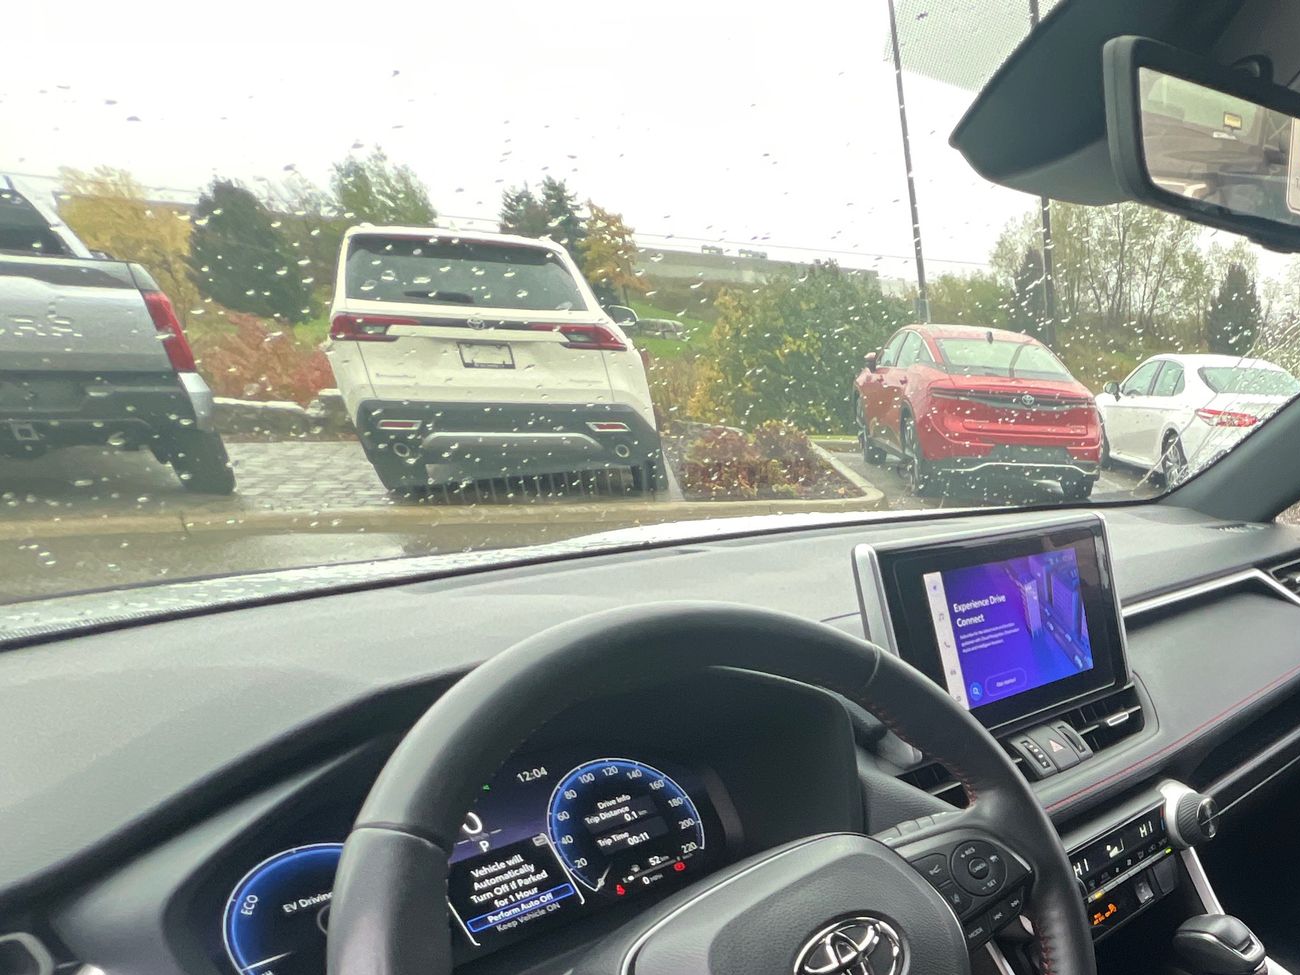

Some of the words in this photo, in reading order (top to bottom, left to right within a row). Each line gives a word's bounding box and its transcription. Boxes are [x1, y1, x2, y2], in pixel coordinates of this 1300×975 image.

[953, 598, 990, 614] Experience
[989, 594, 1007, 606] Drive
[956, 613, 985, 628] Connect
[516, 766, 548, 782] 12:04
[602, 765, 619, 777] 120
[626, 768, 643, 781] 140
[578, 772, 595, 784] 100
[649, 779, 665, 791] 160
[563, 789, 578, 800] 80
[597, 797, 616, 810] Drive
[616, 793, 631, 803] Info
[668, 796, 684, 808] 180
[557, 810, 570, 822] 60
[584, 814, 600, 825] Trip
[600, 806, 630, 822] Distance
[623, 810, 638, 822] 0.1
[678, 817, 695, 830] 200
[1139, 820, 1154, 838] HI
[560, 834, 574, 845] 40
[597, 836, 613, 848] Trip
[612, 832, 630, 842] Time
[627, 832, 650, 846] 00:11
[479, 840, 490, 853] P
[680, 841, 698, 854] 220
[470, 860, 506, 878] Vehicle
[505, 853, 524, 868] will
[574, 857, 588, 869] 20
[648, 855, 662, 866] 52
[1072, 858, 1090, 878] HI
[473, 863, 535, 891] Automatically
[642, 875, 650, 885] 0
[470, 891, 494, 904] Turn
[493, 884, 509, 896] Off
[509, 880, 517, 891] if
[518, 869, 548, 887] Parked
[493, 898, 509, 908] for
[509, 894, 515, 903] 1
[515, 886, 539, 901] Hour
[240, 894, 258, 916] ECO
[282, 902, 298, 914] EV
[487, 907, 521, 923] Perform
[521, 899, 540, 911] Auto
[540, 892, 554, 903] Off
[496, 920, 518, 932] Keep
[518, 908, 547, 923] Vehicle
[546, 902, 561, 912] ON
